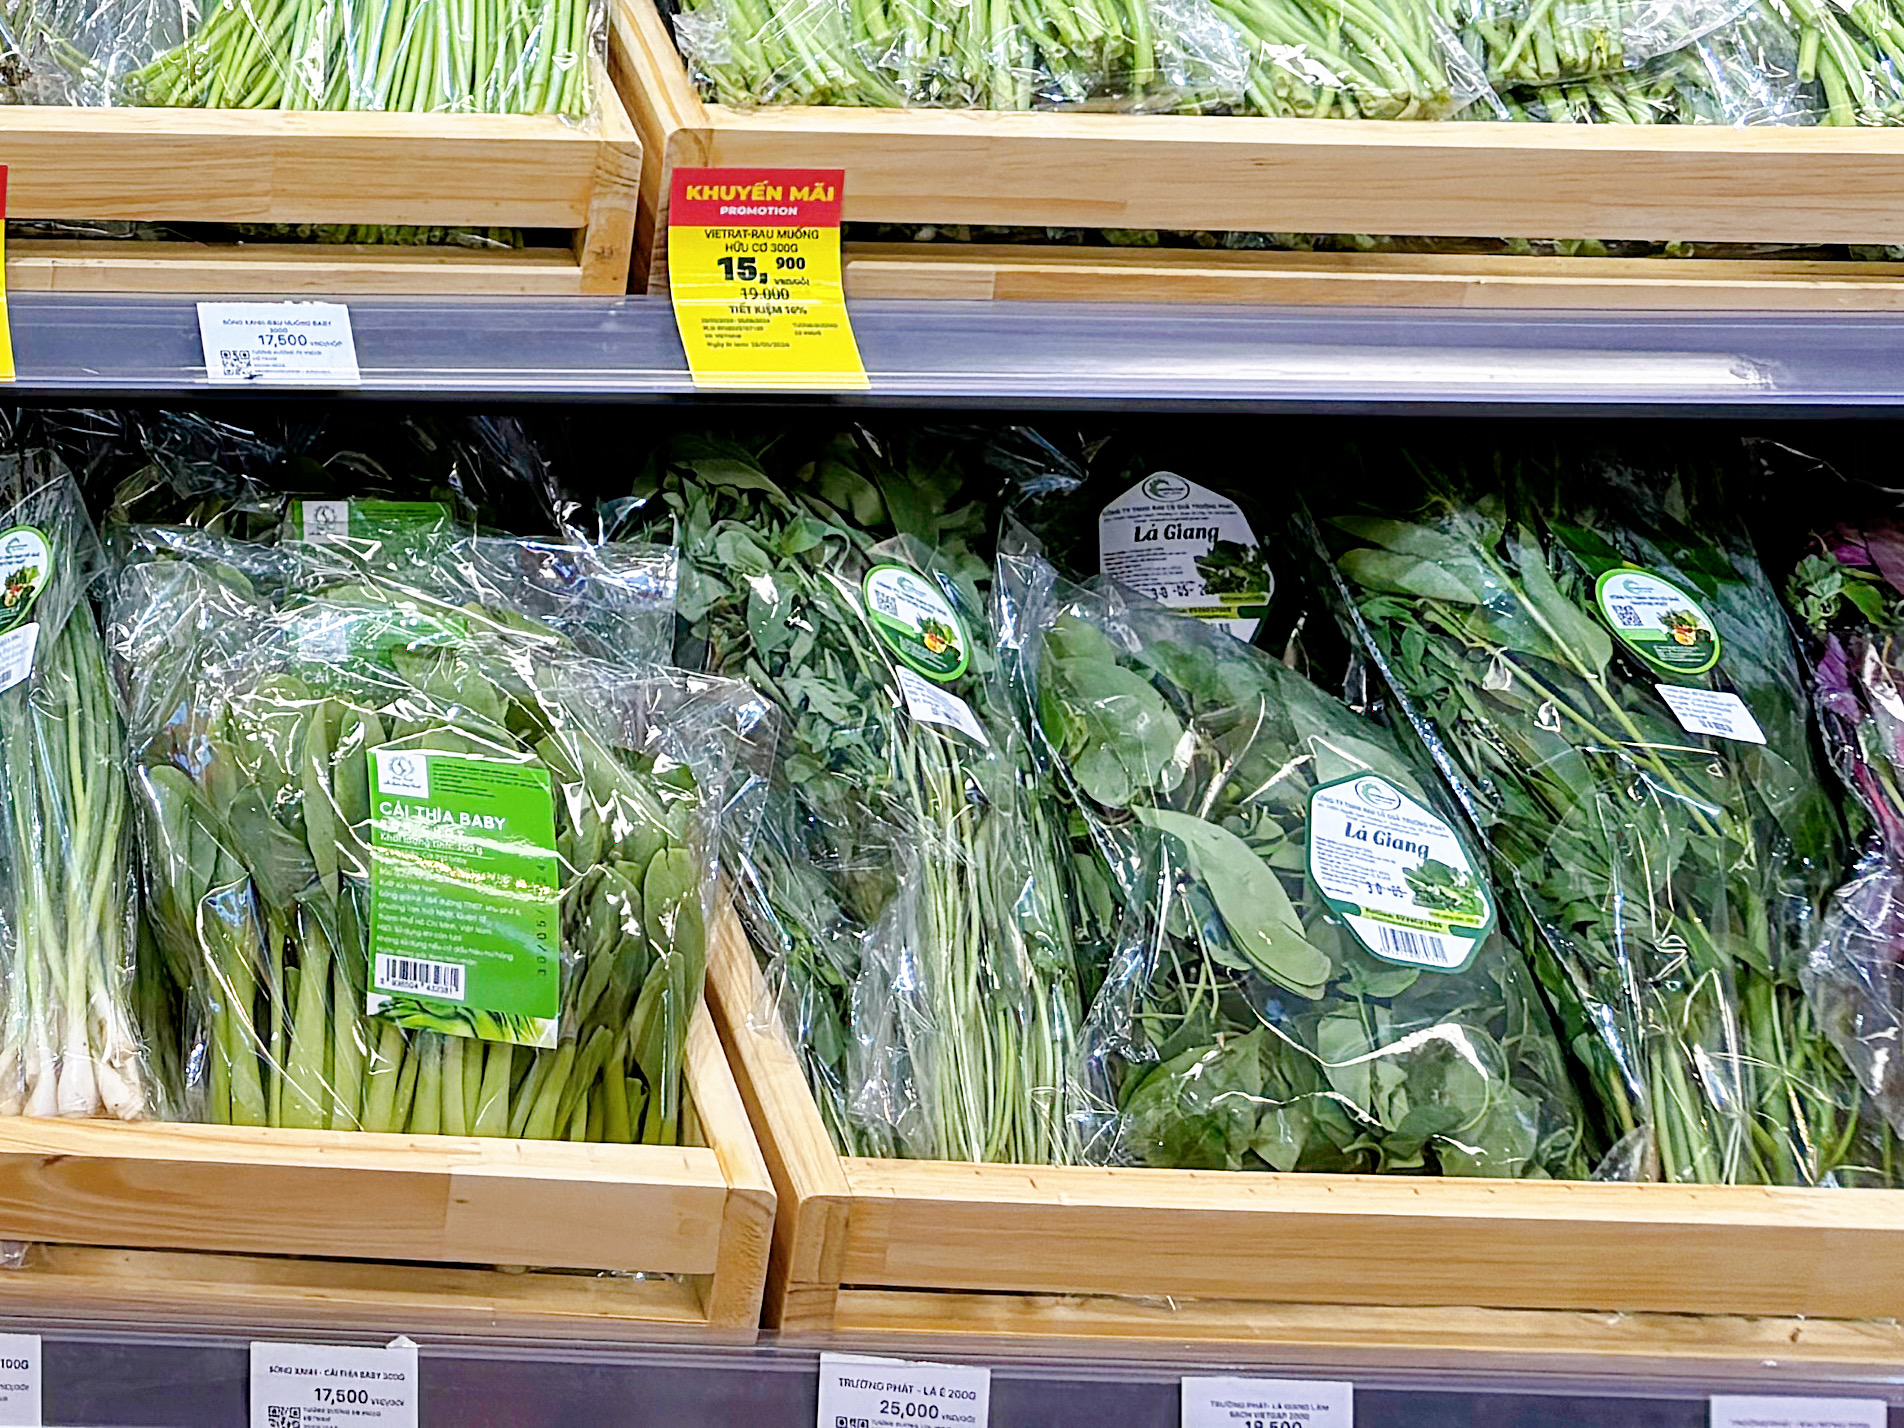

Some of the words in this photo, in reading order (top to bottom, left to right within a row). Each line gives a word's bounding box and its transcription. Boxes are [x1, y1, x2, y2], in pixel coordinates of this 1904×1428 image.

[685, 179, 784, 202] KHUYẾN
[789, 182, 834, 202] MÃI
[719, 204, 798, 216] PROMOTION
[775, 256, 805, 270] 900
[258, 334, 308, 348] 17,500
[459, 811, 507, 832] BABY
[1344, 821, 1367, 842] Lá
[1373, 830, 1430, 860] Giang
[879, 1399, 940, 1420] 25,000
